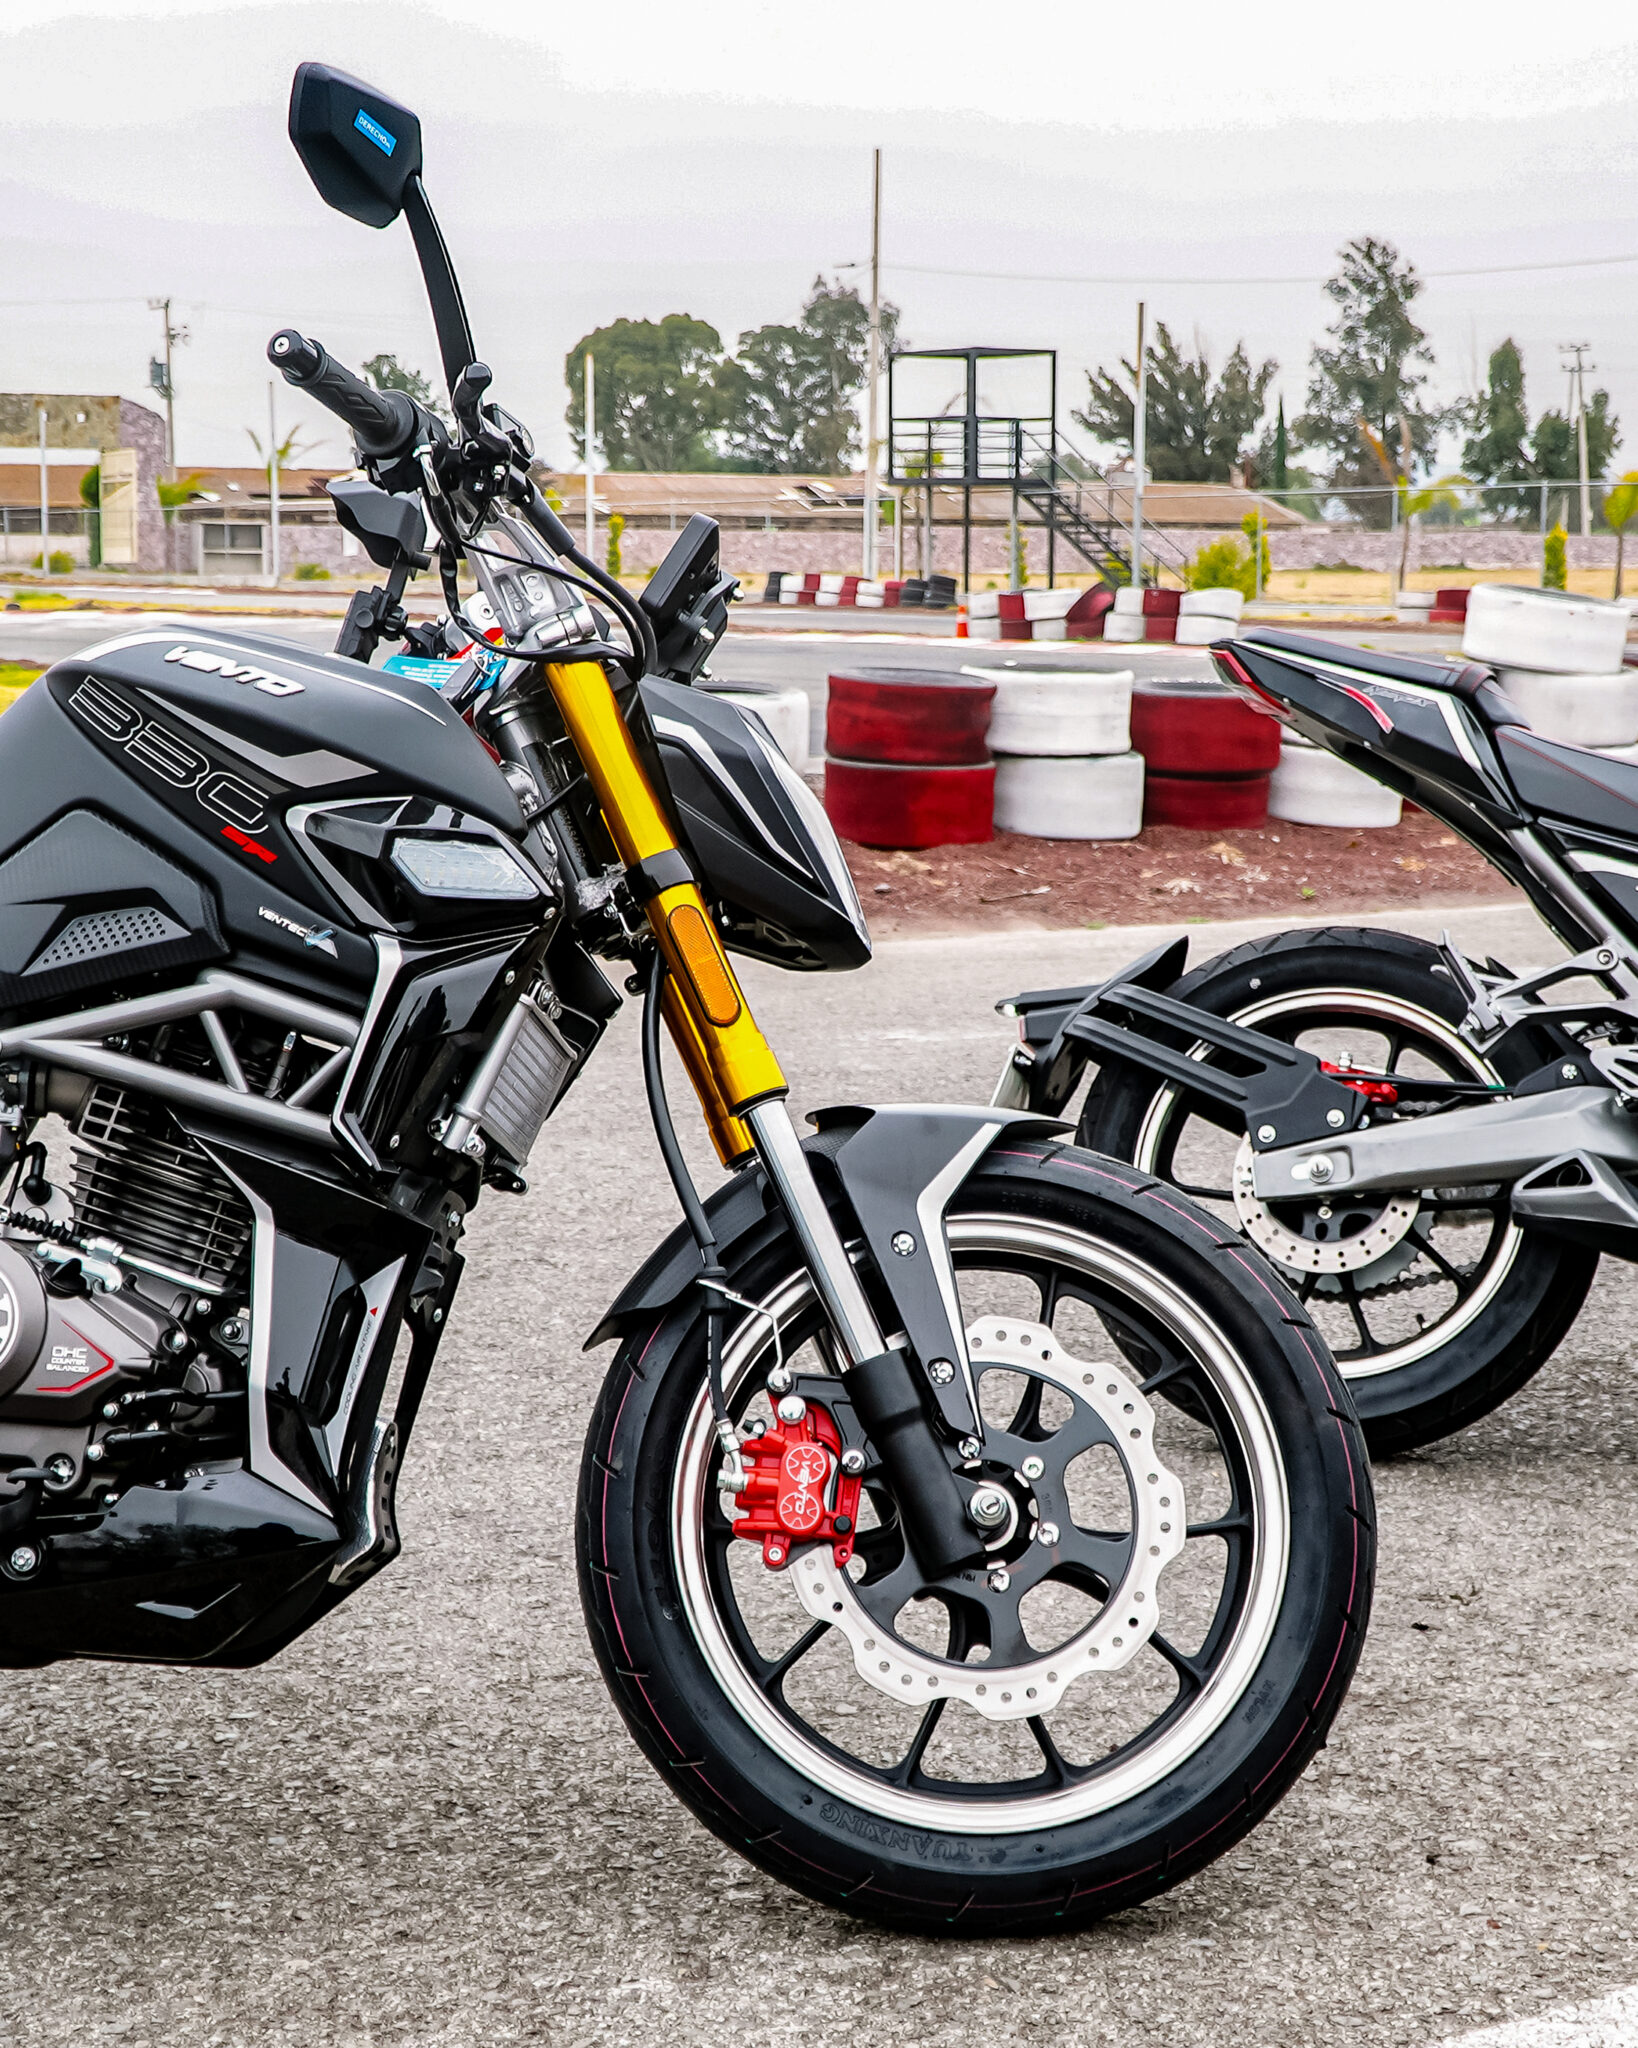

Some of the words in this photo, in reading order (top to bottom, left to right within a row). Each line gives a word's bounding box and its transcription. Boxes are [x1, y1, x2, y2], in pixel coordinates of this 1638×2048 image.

[164, 646, 306, 697] VENTO
[46, 1364, 90, 1372] BALANCED
[51, 1357, 86, 1365] COUNTER
[797, 1461, 811, 1515] VENTO
